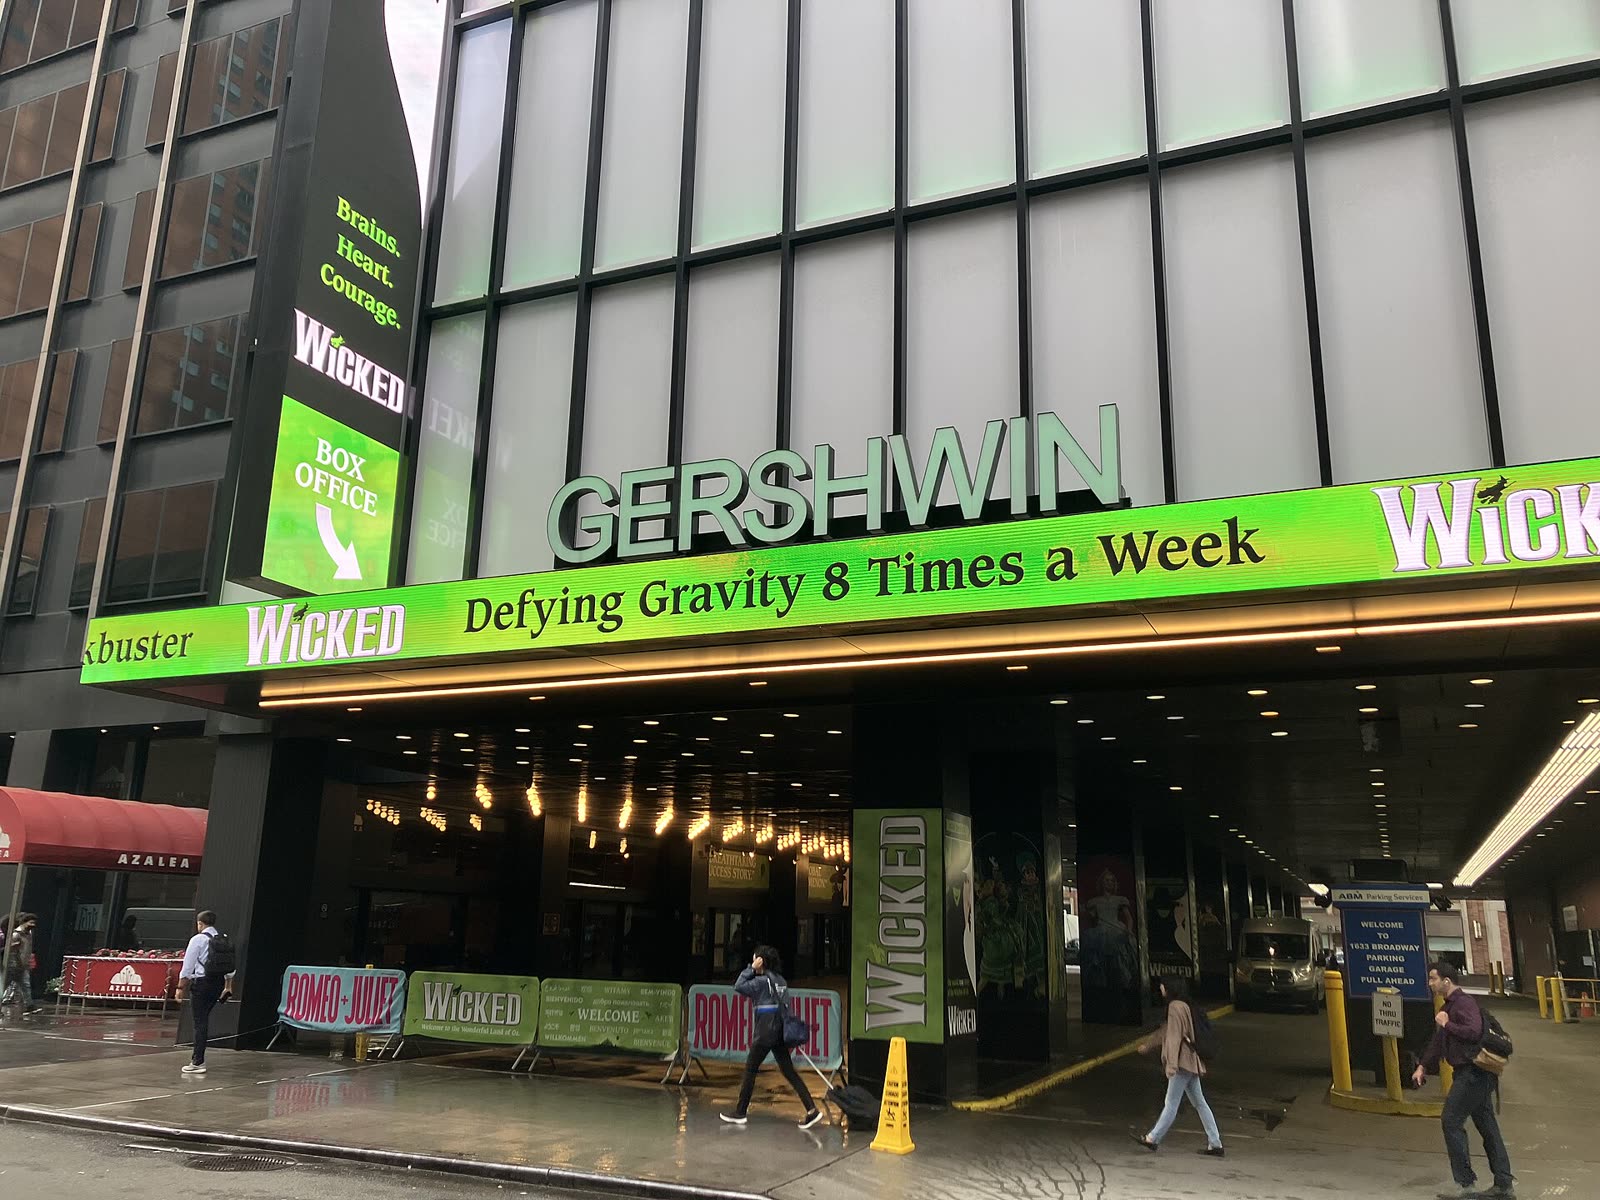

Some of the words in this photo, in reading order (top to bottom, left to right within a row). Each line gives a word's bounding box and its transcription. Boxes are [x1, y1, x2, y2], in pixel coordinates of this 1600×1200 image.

[337, 196, 400, 257] Brains.
[336, 233, 394, 288] Heart.
[320, 263, 401, 329] Courage.
[316, 437, 366, 483] BOX
[295, 462, 378, 517] OFFICE
[547, 403, 1120, 563] GERSHWIN
[463, 587, 626, 639] Defying
[639, 568, 806, 618] Gravity
[822, 561, 850, 601] 8
[868, 551, 1024, 597] Times
[1046, 547, 1078, 581] a
[1097, 516, 1265, 576] Week
[118, 854, 190, 868] AZALEA
[1339, 891, 1363, 900] ABM
[1366, 893, 1392, 902] Parking
[1393, 893, 1423, 901] Services
[1361, 921, 1404, 929] WELCOME
[1371, 943, 1420, 951] BROADWAY
[109, 984, 142, 992] AZALEA
[1385, 977, 1415, 985] AHEAD
[284, 972, 342, 1024] ROMEO
[344, 975, 399, 1024] JULIET
[577, 1007, 640, 1024] WELCOME
[1379, 1009, 1397, 1018] THRU
[1375, 1018, 1401, 1027] TRAFFIC
